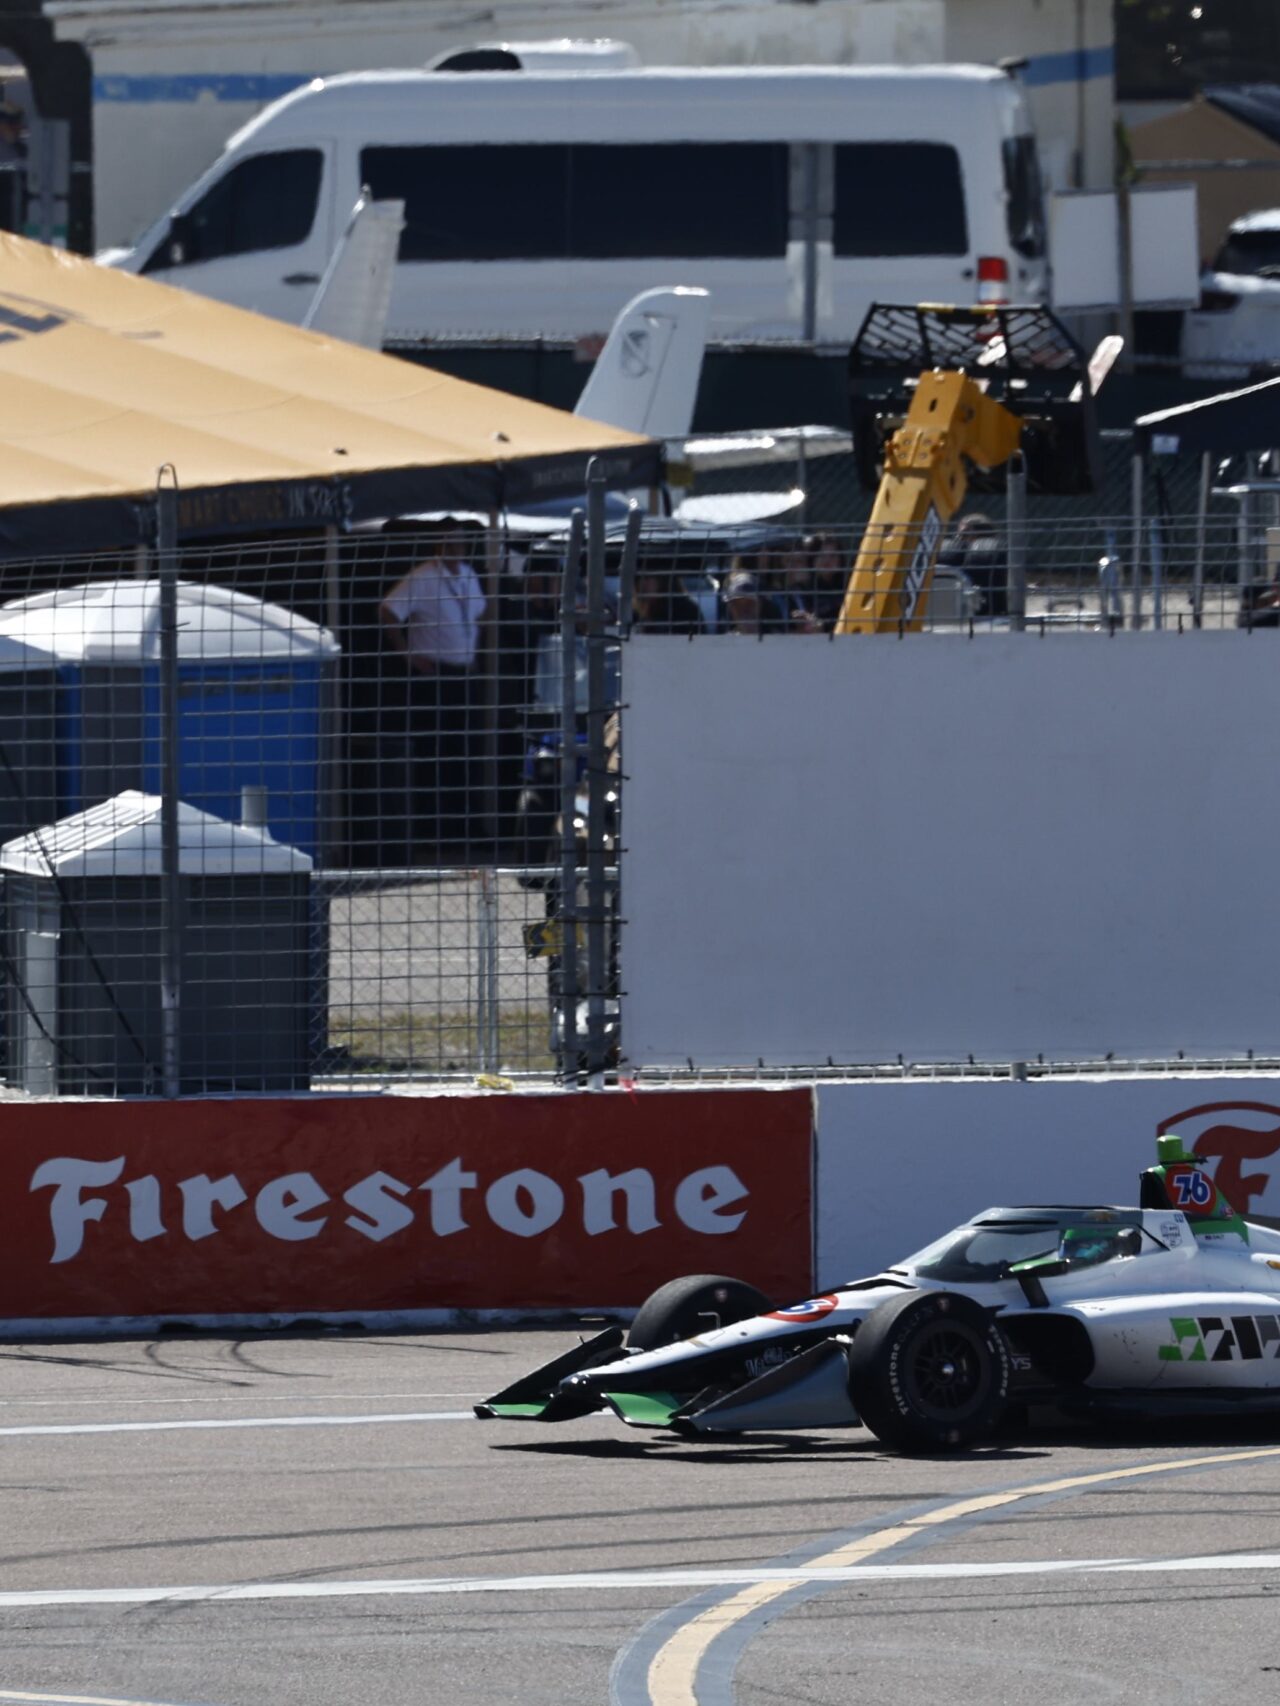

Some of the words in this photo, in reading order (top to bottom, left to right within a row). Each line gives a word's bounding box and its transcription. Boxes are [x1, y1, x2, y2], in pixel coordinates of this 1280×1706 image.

[904, 506, 940, 621] JCB
[29, 1155, 750, 1263] Firestone
[1172, 1171, 1211, 1205] 76
[888, 1341, 910, 1416] Firestone
